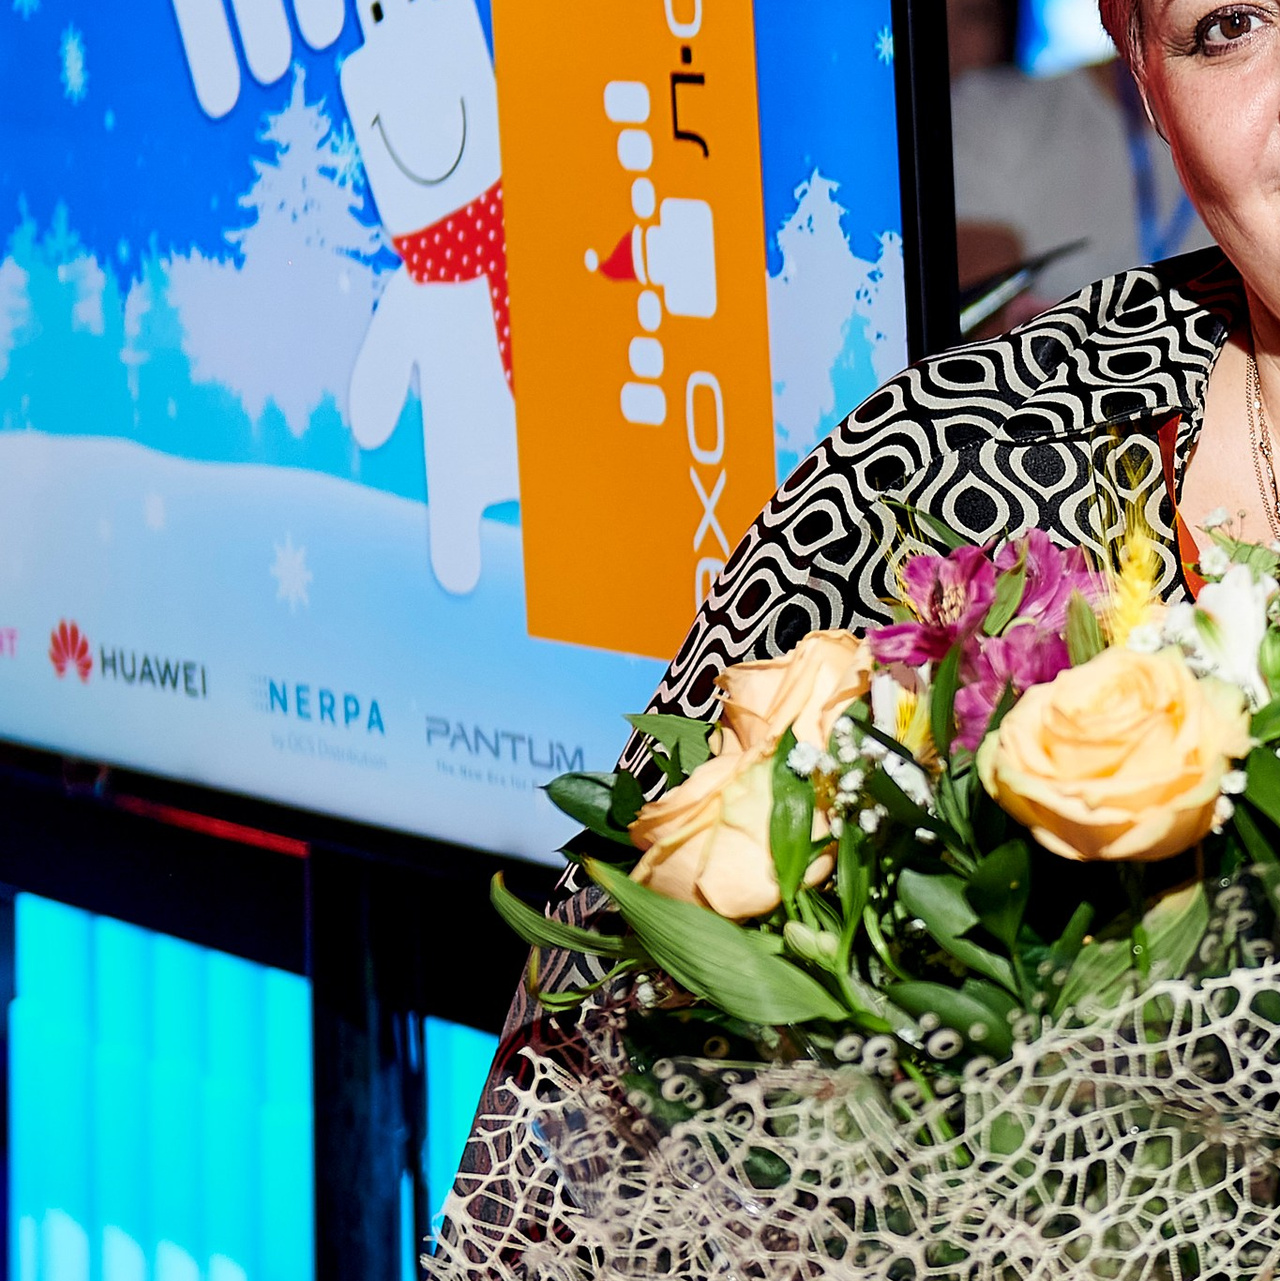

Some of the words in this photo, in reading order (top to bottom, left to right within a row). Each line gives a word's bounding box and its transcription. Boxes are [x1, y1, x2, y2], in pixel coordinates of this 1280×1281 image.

[100, 642, 207, 699] HUAWEI
[268, 678, 386, 736] NERPA
[425, 715, 585, 773] PANTUM
